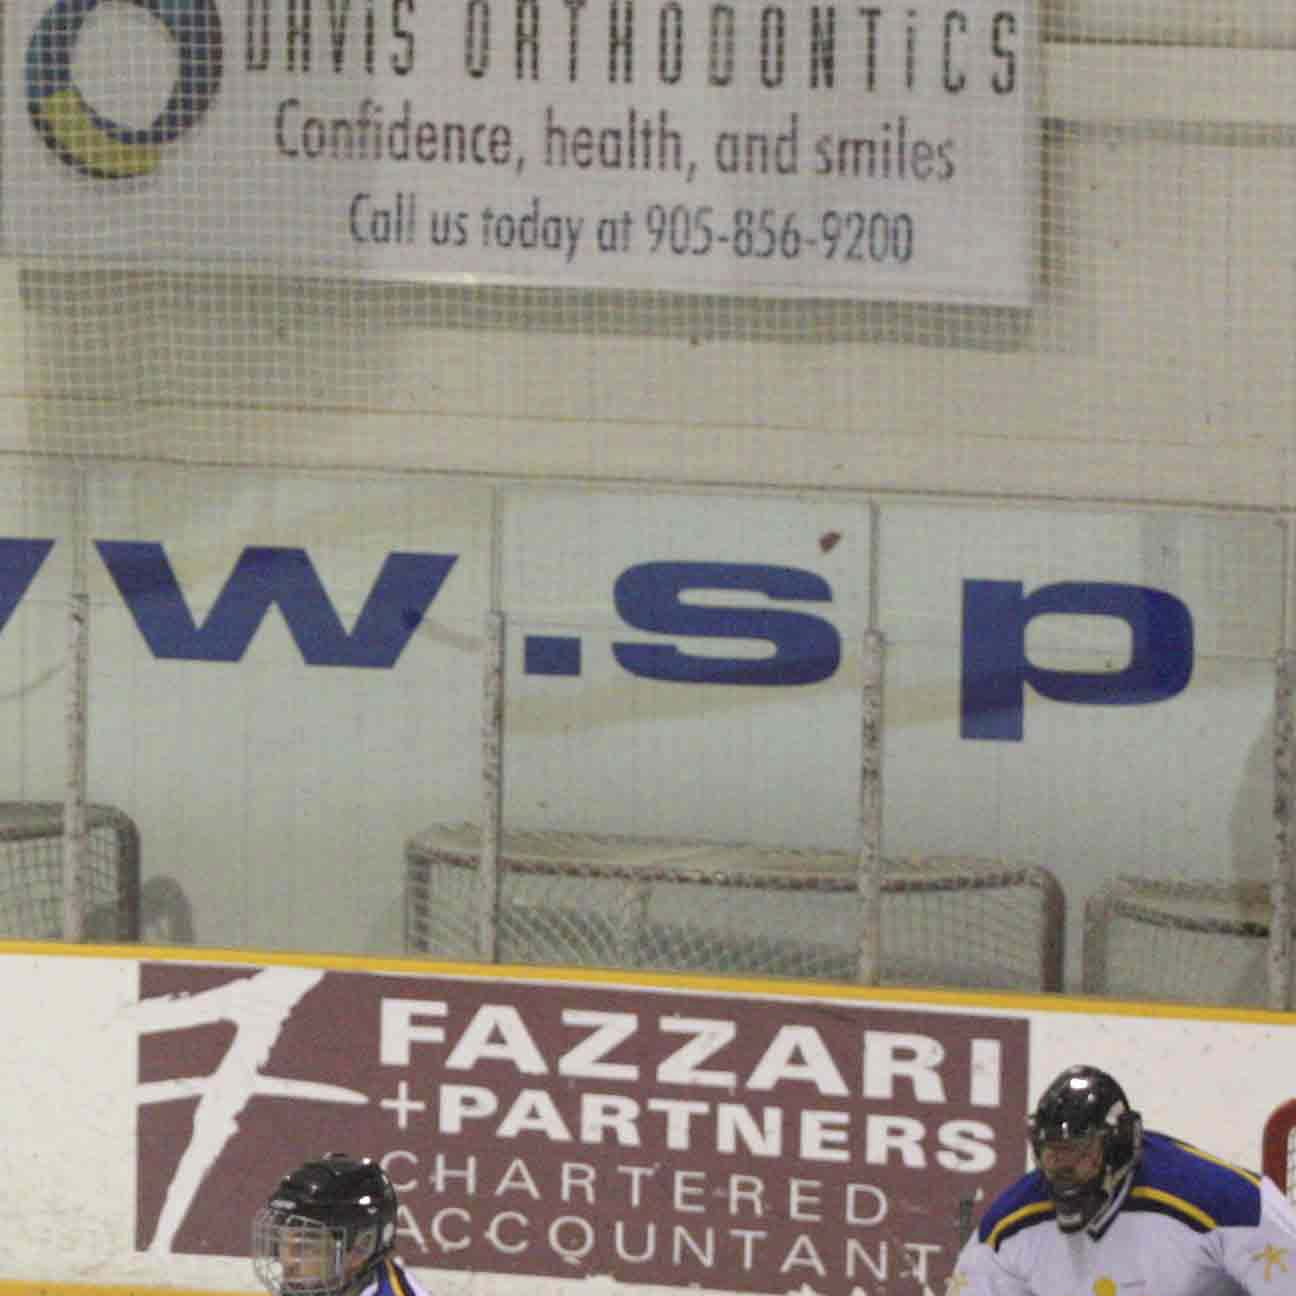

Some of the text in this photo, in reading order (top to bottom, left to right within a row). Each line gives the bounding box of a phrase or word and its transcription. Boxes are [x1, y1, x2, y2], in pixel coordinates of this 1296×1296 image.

[275, 98, 957, 183] Confidence, health, and smiles
[349, 193, 913, 264] Call us today at 905-856-9200
[380, 997, 1001, 1107] FAZZARI
[380, 1150, 888, 1226] CHARTERED
